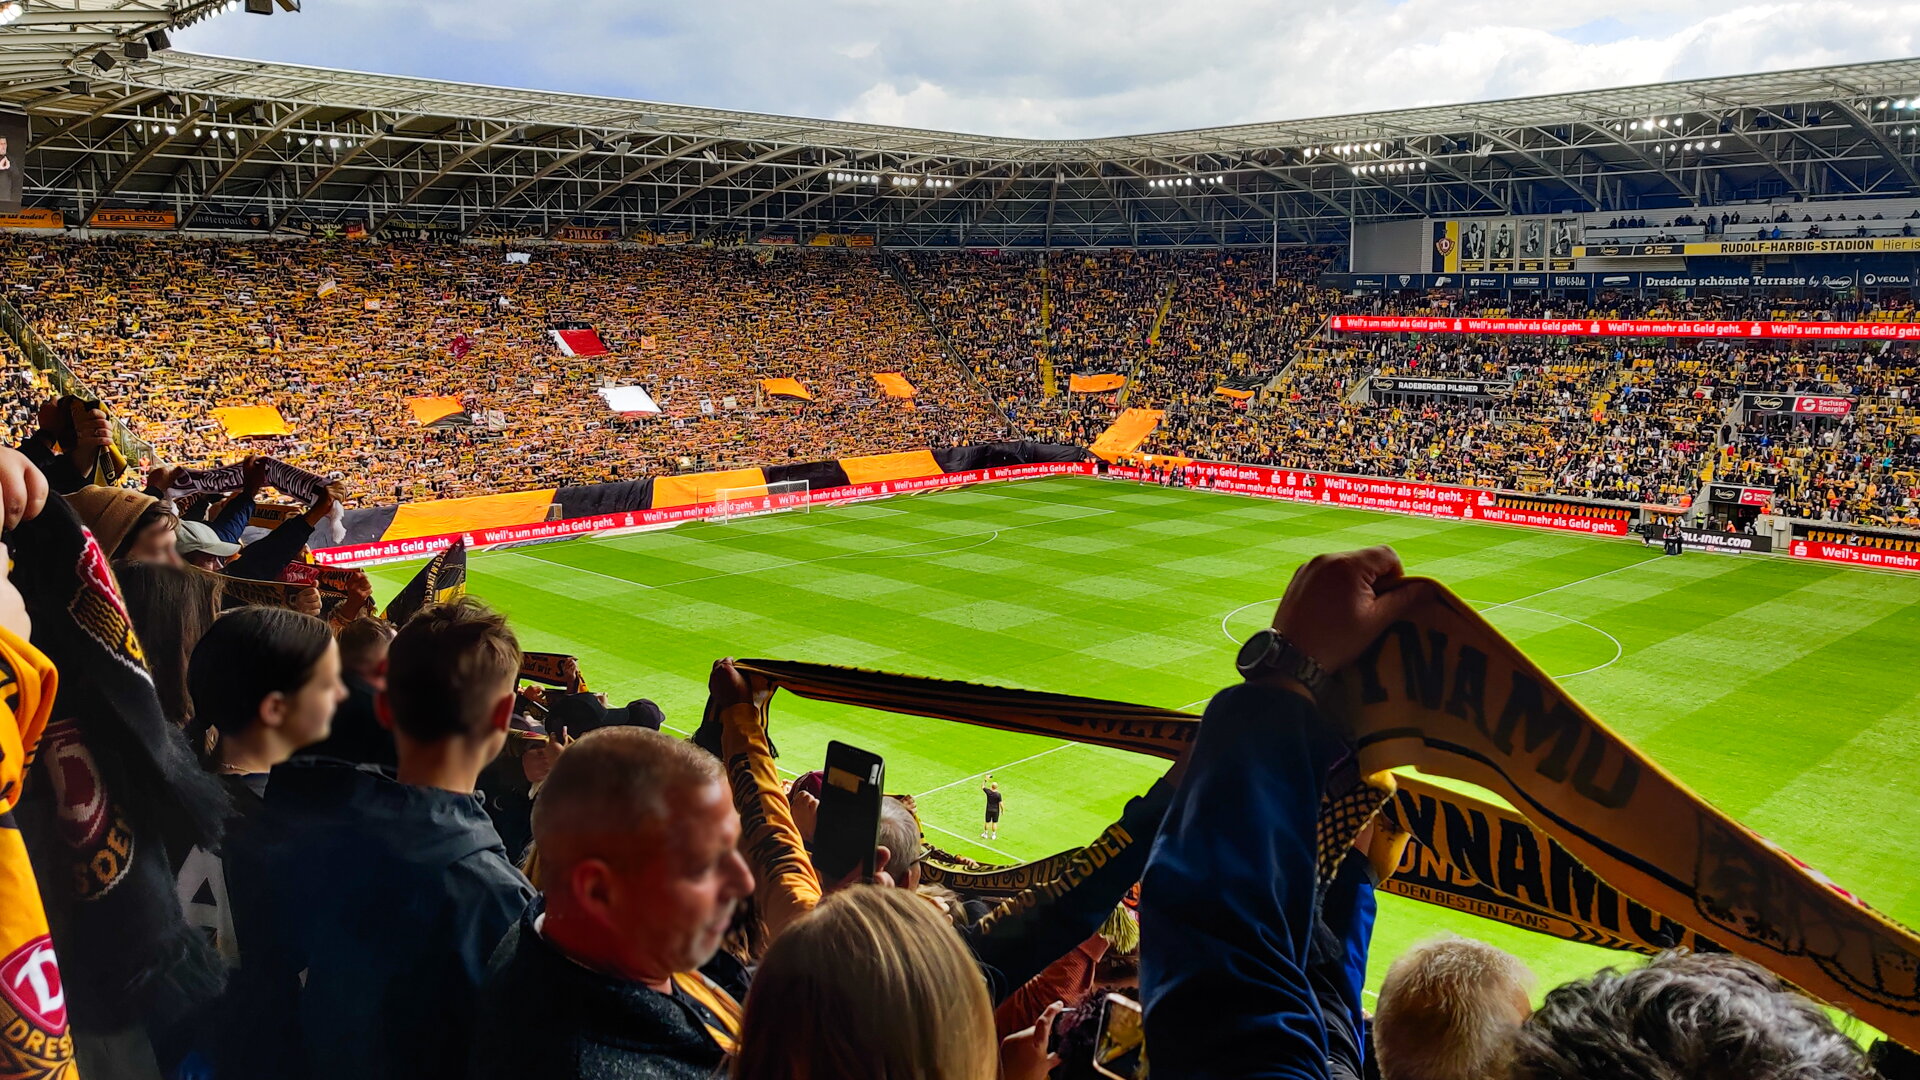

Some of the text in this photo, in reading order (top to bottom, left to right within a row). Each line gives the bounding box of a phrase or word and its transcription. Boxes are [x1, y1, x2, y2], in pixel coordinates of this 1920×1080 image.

[1721, 240, 1874, 253] RUDOLF-HARBIG-STADION
[1883, 239, 1905, 250] Hier
[1646, 277, 1697, 287] Dresdens
[1699, 276, 1750, 286] schönste
[1753, 276, 1806, 286] Terrasse
[1809, 276, 1819, 287] by
[1347, 319, 1367, 327] Weil's
[1377, 319, 1399, 327] mehr
[1400, 319, 1410, 327] als
[1411, 319, 1428, 327] Geld
[1429, 320, 1447, 330] geht.
[1469, 321, 1492, 329] Weil's
[1507, 321, 1527, 330] mehr
[1529, 321, 1540, 330] als
[1542, 321, 1560, 330] Geld
[1561, 322, 1583, 333] geht.
[1608, 322, 1634, 332] Weil's
[1652, 323, 1677, 332] mehr
[1678, 323, 1691, 333] als
[1693, 324, 1715, 333] Geld
[1717, 324, 1742, 336] geht.
[1771, 324, 1920, 338] Weil's um mehr als Geld geh
[1398, 381, 1478, 393] RADEBERGER PILSNER
[1818, 399, 1848, 407] Sachsen
[1818, 405, 1845, 413] Energie
[995, 468, 1012, 477] Weil's
[1022, 466, 1038, 474] mehr
[1049, 464, 1066, 472] Geld
[1206, 466, 1218, 474] als
[1219, 467, 1241, 477] Geld
[1241, 469, 1259, 480] geht.
[894, 481, 913, 490] Weil's
[924, 477, 939, 486] mehr
[940, 476, 948, 484] als
[949, 474, 962, 483] Geld
[963, 473, 977, 483] geht.
[1214, 479, 1234, 489] Weil's
[1247, 483, 1265, 492] mehr
[1266, 485, 1276, 493] als
[1277, 486, 1294, 495] Geld
[1295, 488, 1314, 498] geht.
[1324, 477, 1352, 490] Weil's
[1370, 483, 1396, 495] mehr
[1396, 485, 1411, 496] als
[1437, 490, 1464, 502] geht.
[813, 491, 831, 500] mehr
[831, 490, 841, 498] als
[841, 487, 857, 497] Geld
[857, 486, 874, 496] geht.
[643, 511, 668, 522] Weil's
[669, 510, 682, 519] um
[683, 506, 703, 517] mehr
[705, 505, 717, 514] als
[736, 501, 755, 512] geht.
[1339, 492, 1362, 503] Weil's
[1363, 496, 1376, 505] um
[1377, 497, 1398, 507] mehr
[1399, 499, 1411, 509] als
[1412, 501, 1431, 511] Geld
[1432, 503, 1454, 514] geht.
[485, 517, 615, 541] Weil's um mehr als Geld geht.
[1483, 508, 1618, 533] Weil's um mehr als Geld geht.
[334, 551, 353, 561] um
[354, 546, 383, 559] mehr
[383, 545, 399, 556] als
[401, 540, 424, 553] Geld
[1822, 546, 1919, 567] Weil's um mehr
[1357, 619, 1642, 810] YNAMO
[1383, 787, 1687, 947] YNAMO
[1398, 882, 1431, 900] DEN
[1435, 891, 1500, 918] BESTEN
[1503, 907, 1550, 930] FANS
[4, 1017, 74, 1060] DRES
